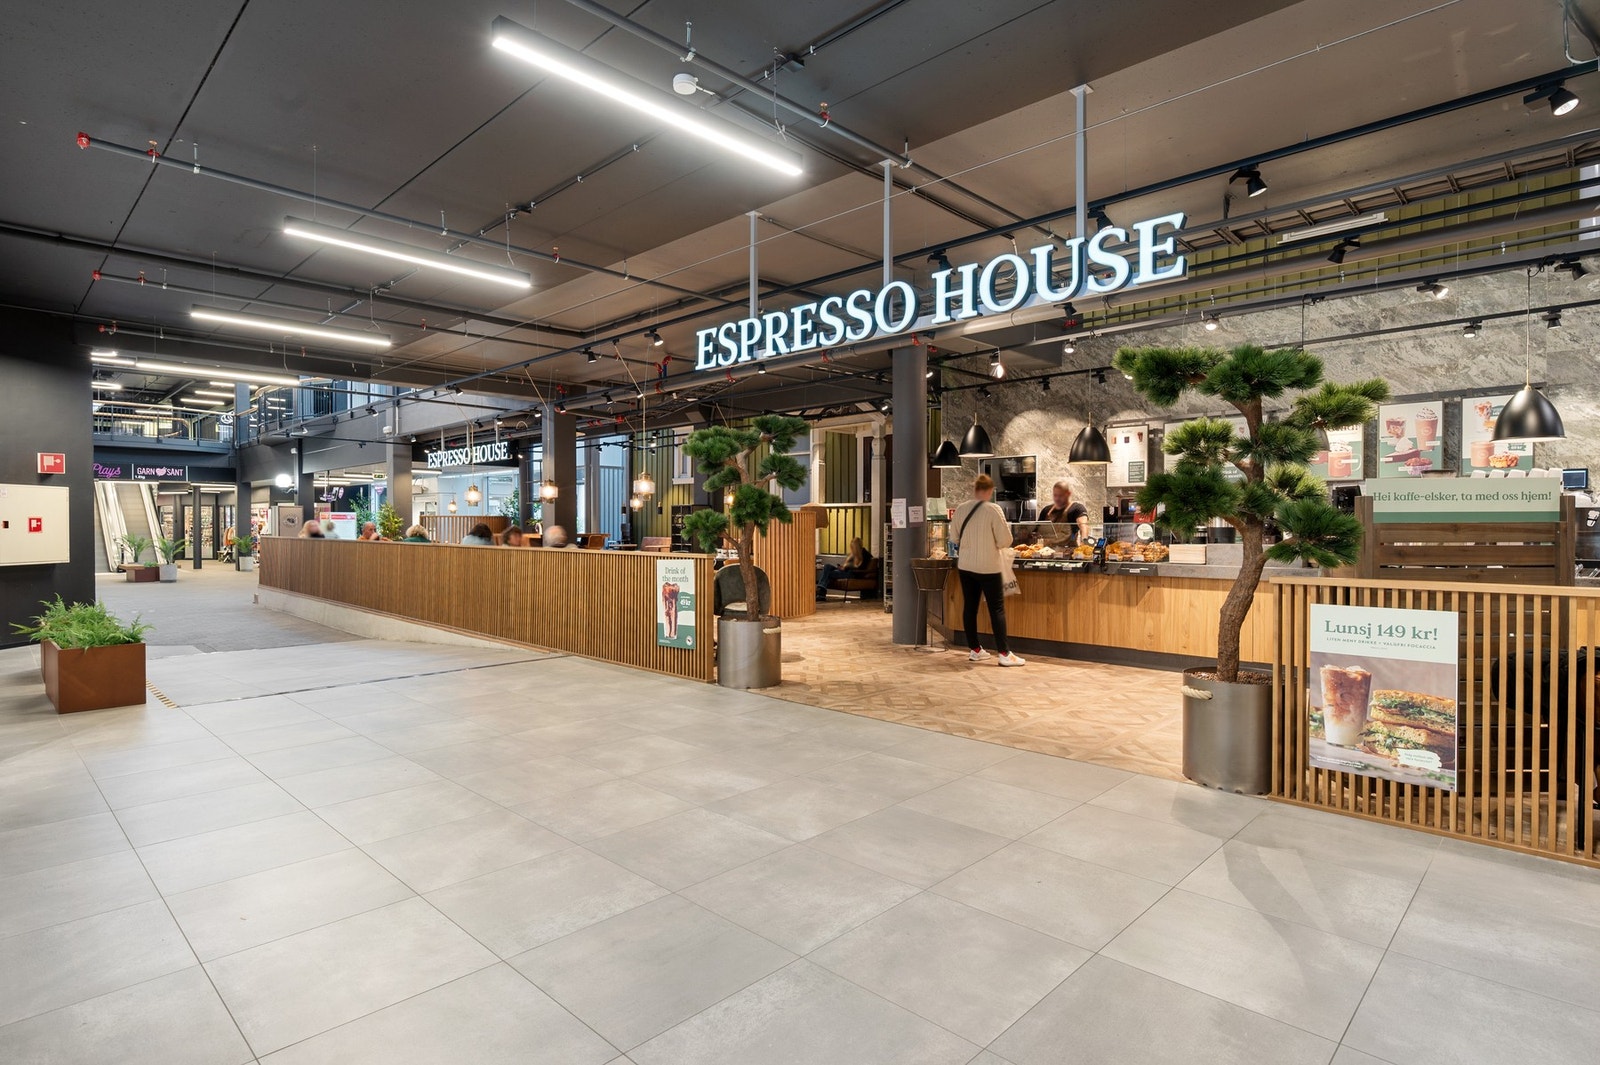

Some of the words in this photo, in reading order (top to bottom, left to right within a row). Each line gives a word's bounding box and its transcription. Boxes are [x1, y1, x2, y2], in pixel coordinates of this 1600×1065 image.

[694, 280, 920, 371] ESPRESSO
[930, 211, 1188, 325] HOUSE
[427, 447, 470, 468] ESPRESSO
[472, 442, 508, 463] HOUSE
[137, 467, 155, 475] GARN
[1373, 491, 1391, 501] Hei
[1394, 491, 1459, 502] kaffe-elsker,
[1461, 492, 1472, 501] ta
[1475, 491, 1499, 501] med
[1502, 493, 1519, 501] oss
[1520, 491, 1552, 503] hjem!
[665, 567, 679, 575] Drink
[680, 567, 686, 575] of
[1325, 620, 1372, 639] Lunsj
[1376, 623, 1406, 638] 149
[1411, 626, 1439, 641] kr!
